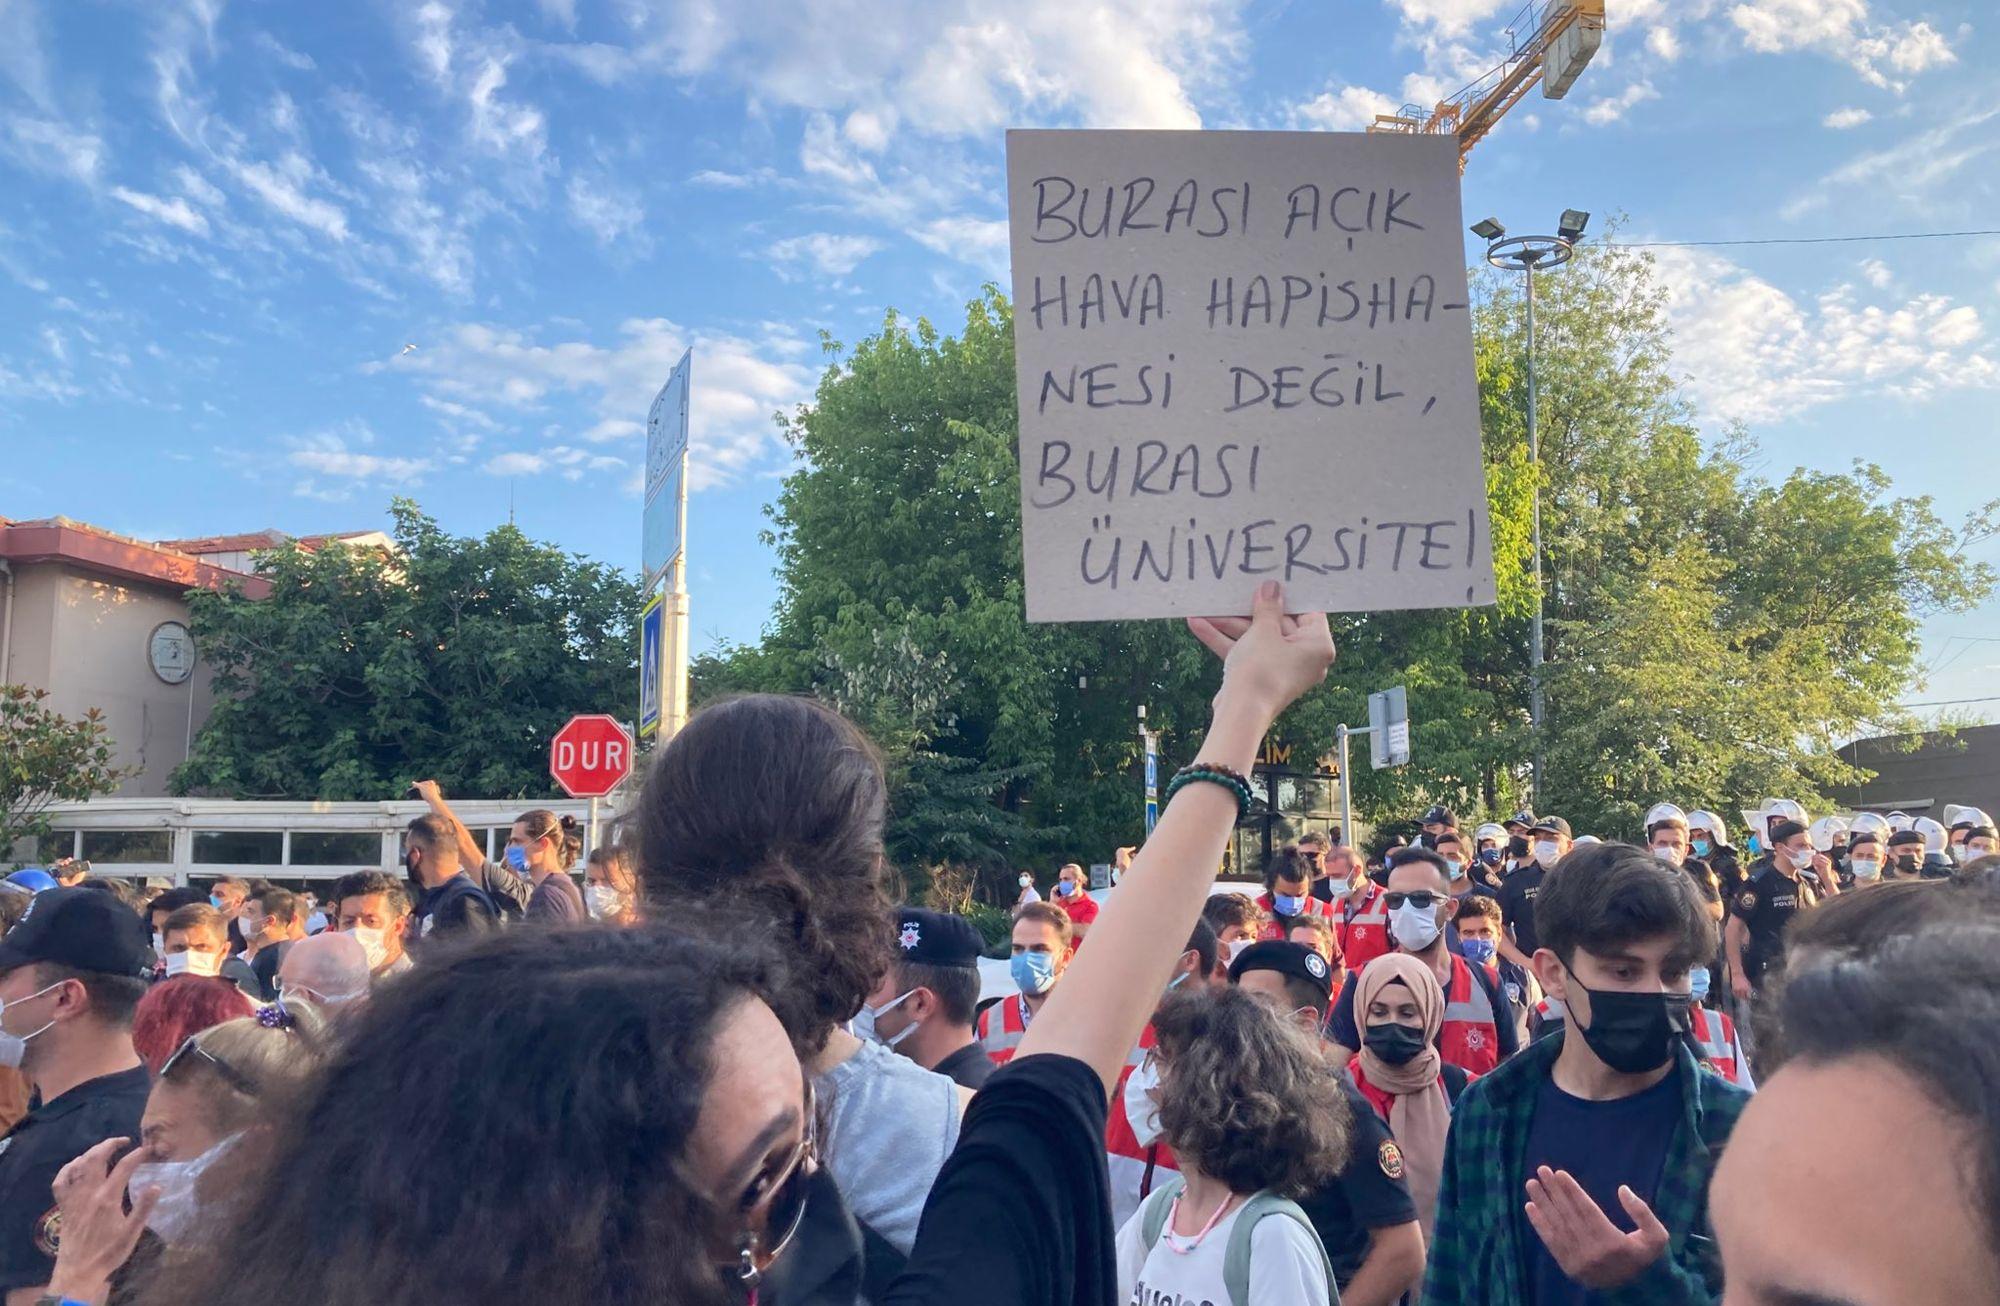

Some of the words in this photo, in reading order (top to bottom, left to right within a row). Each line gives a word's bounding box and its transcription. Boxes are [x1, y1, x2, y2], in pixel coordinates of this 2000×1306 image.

[1030, 176, 1250, 244] BURASI
[1284, 183, 1425, 251] AÇIK
[1030, 273, 1164, 329] HAVA
[1030, 439, 1260, 509] BURASI
[1080, 508, 1476, 602] ÜNİVERSİTE!
[558, 741, 622, 771] DUR
